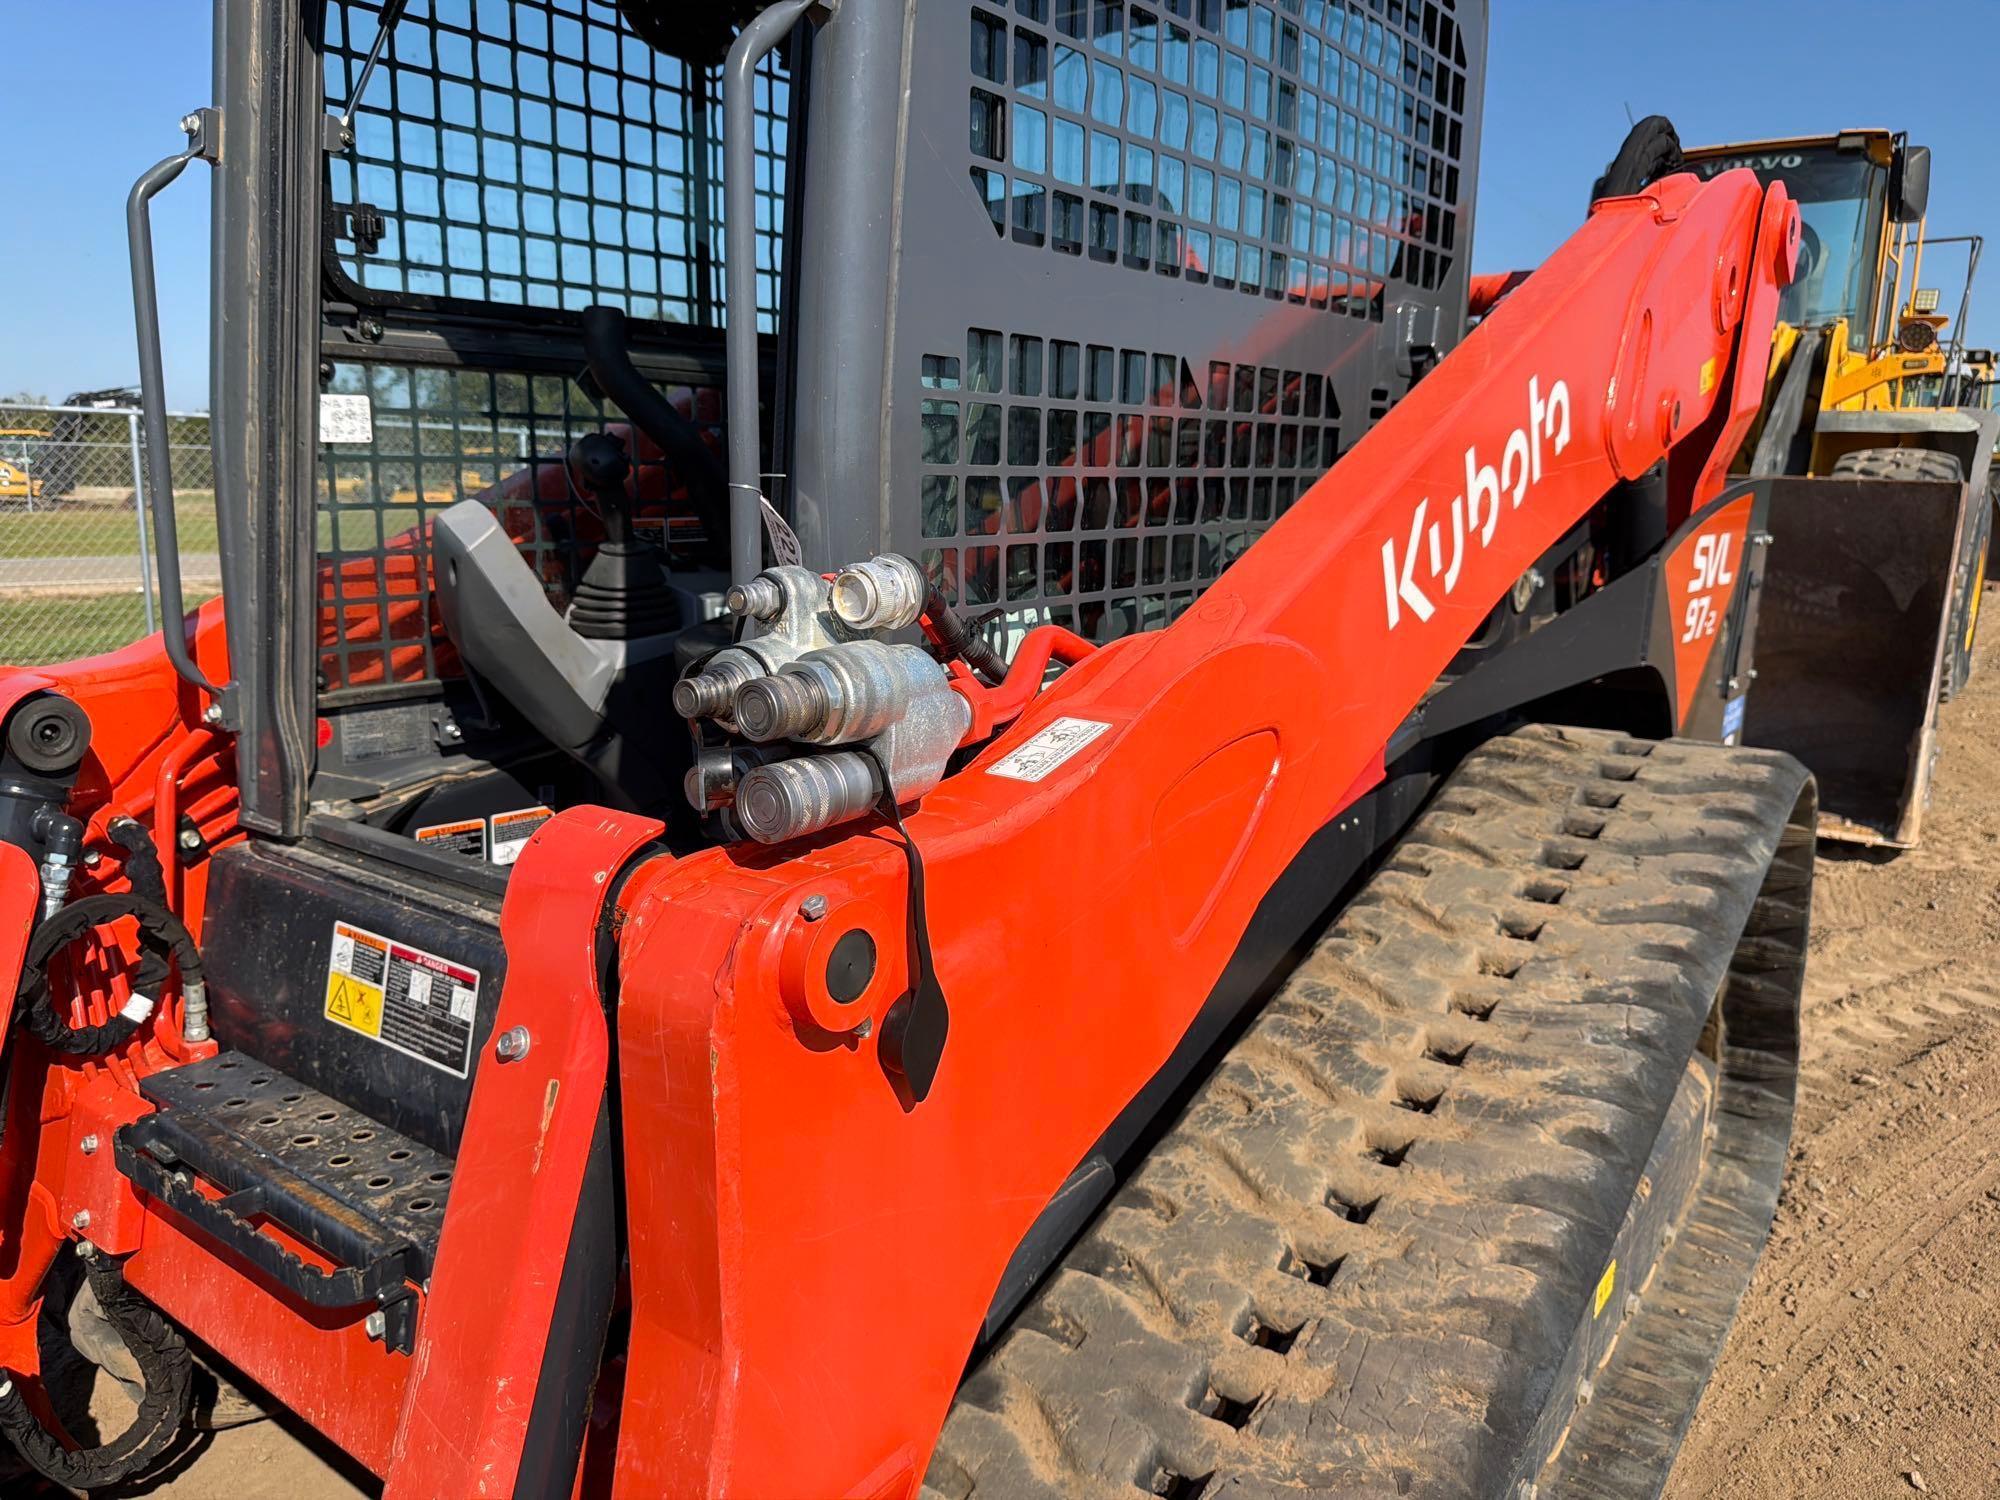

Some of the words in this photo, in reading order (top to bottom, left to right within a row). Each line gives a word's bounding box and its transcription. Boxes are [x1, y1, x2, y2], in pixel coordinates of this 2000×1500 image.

[1382, 374, 1571, 631] Kubota
[1688, 532, 1732, 593] SVL
[1682, 596, 1718, 644] 97-2
